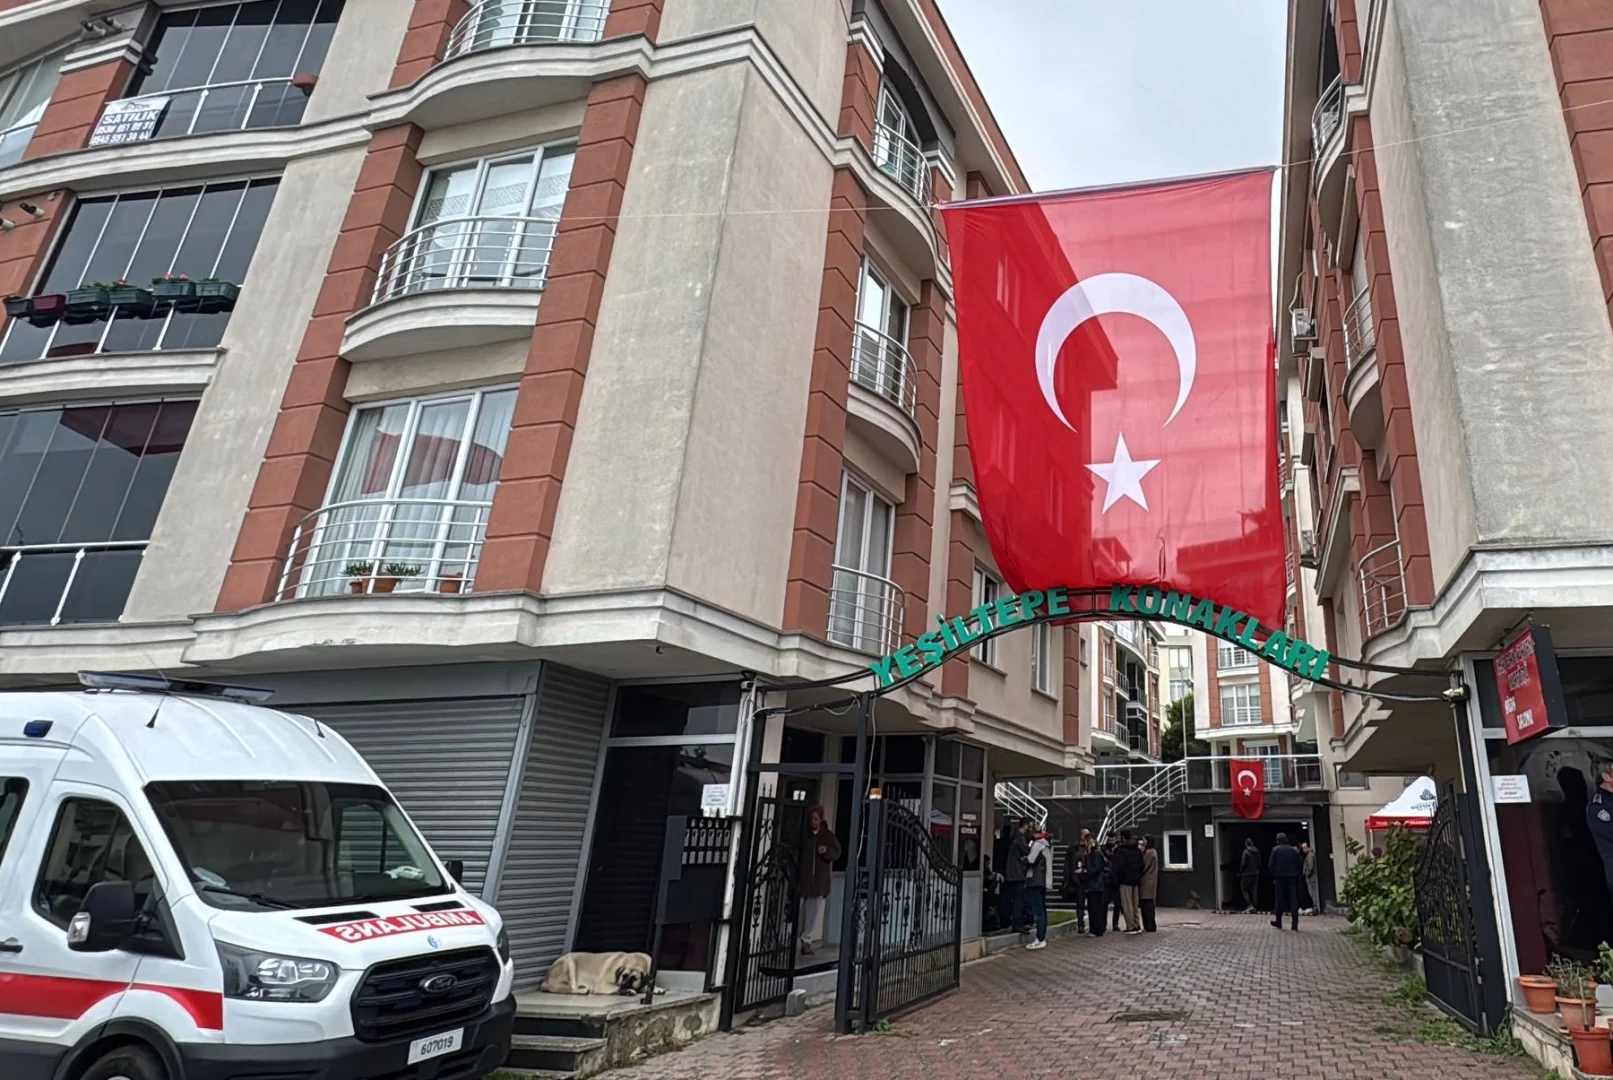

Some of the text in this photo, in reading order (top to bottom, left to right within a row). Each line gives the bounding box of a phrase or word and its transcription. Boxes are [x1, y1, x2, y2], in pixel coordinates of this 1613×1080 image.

[102, 111, 159, 124] SATILIK
[869, 583, 1331, 688] YEŞİLTEPE KONAKLARI
[420, 1035, 454, 1056] 607019
